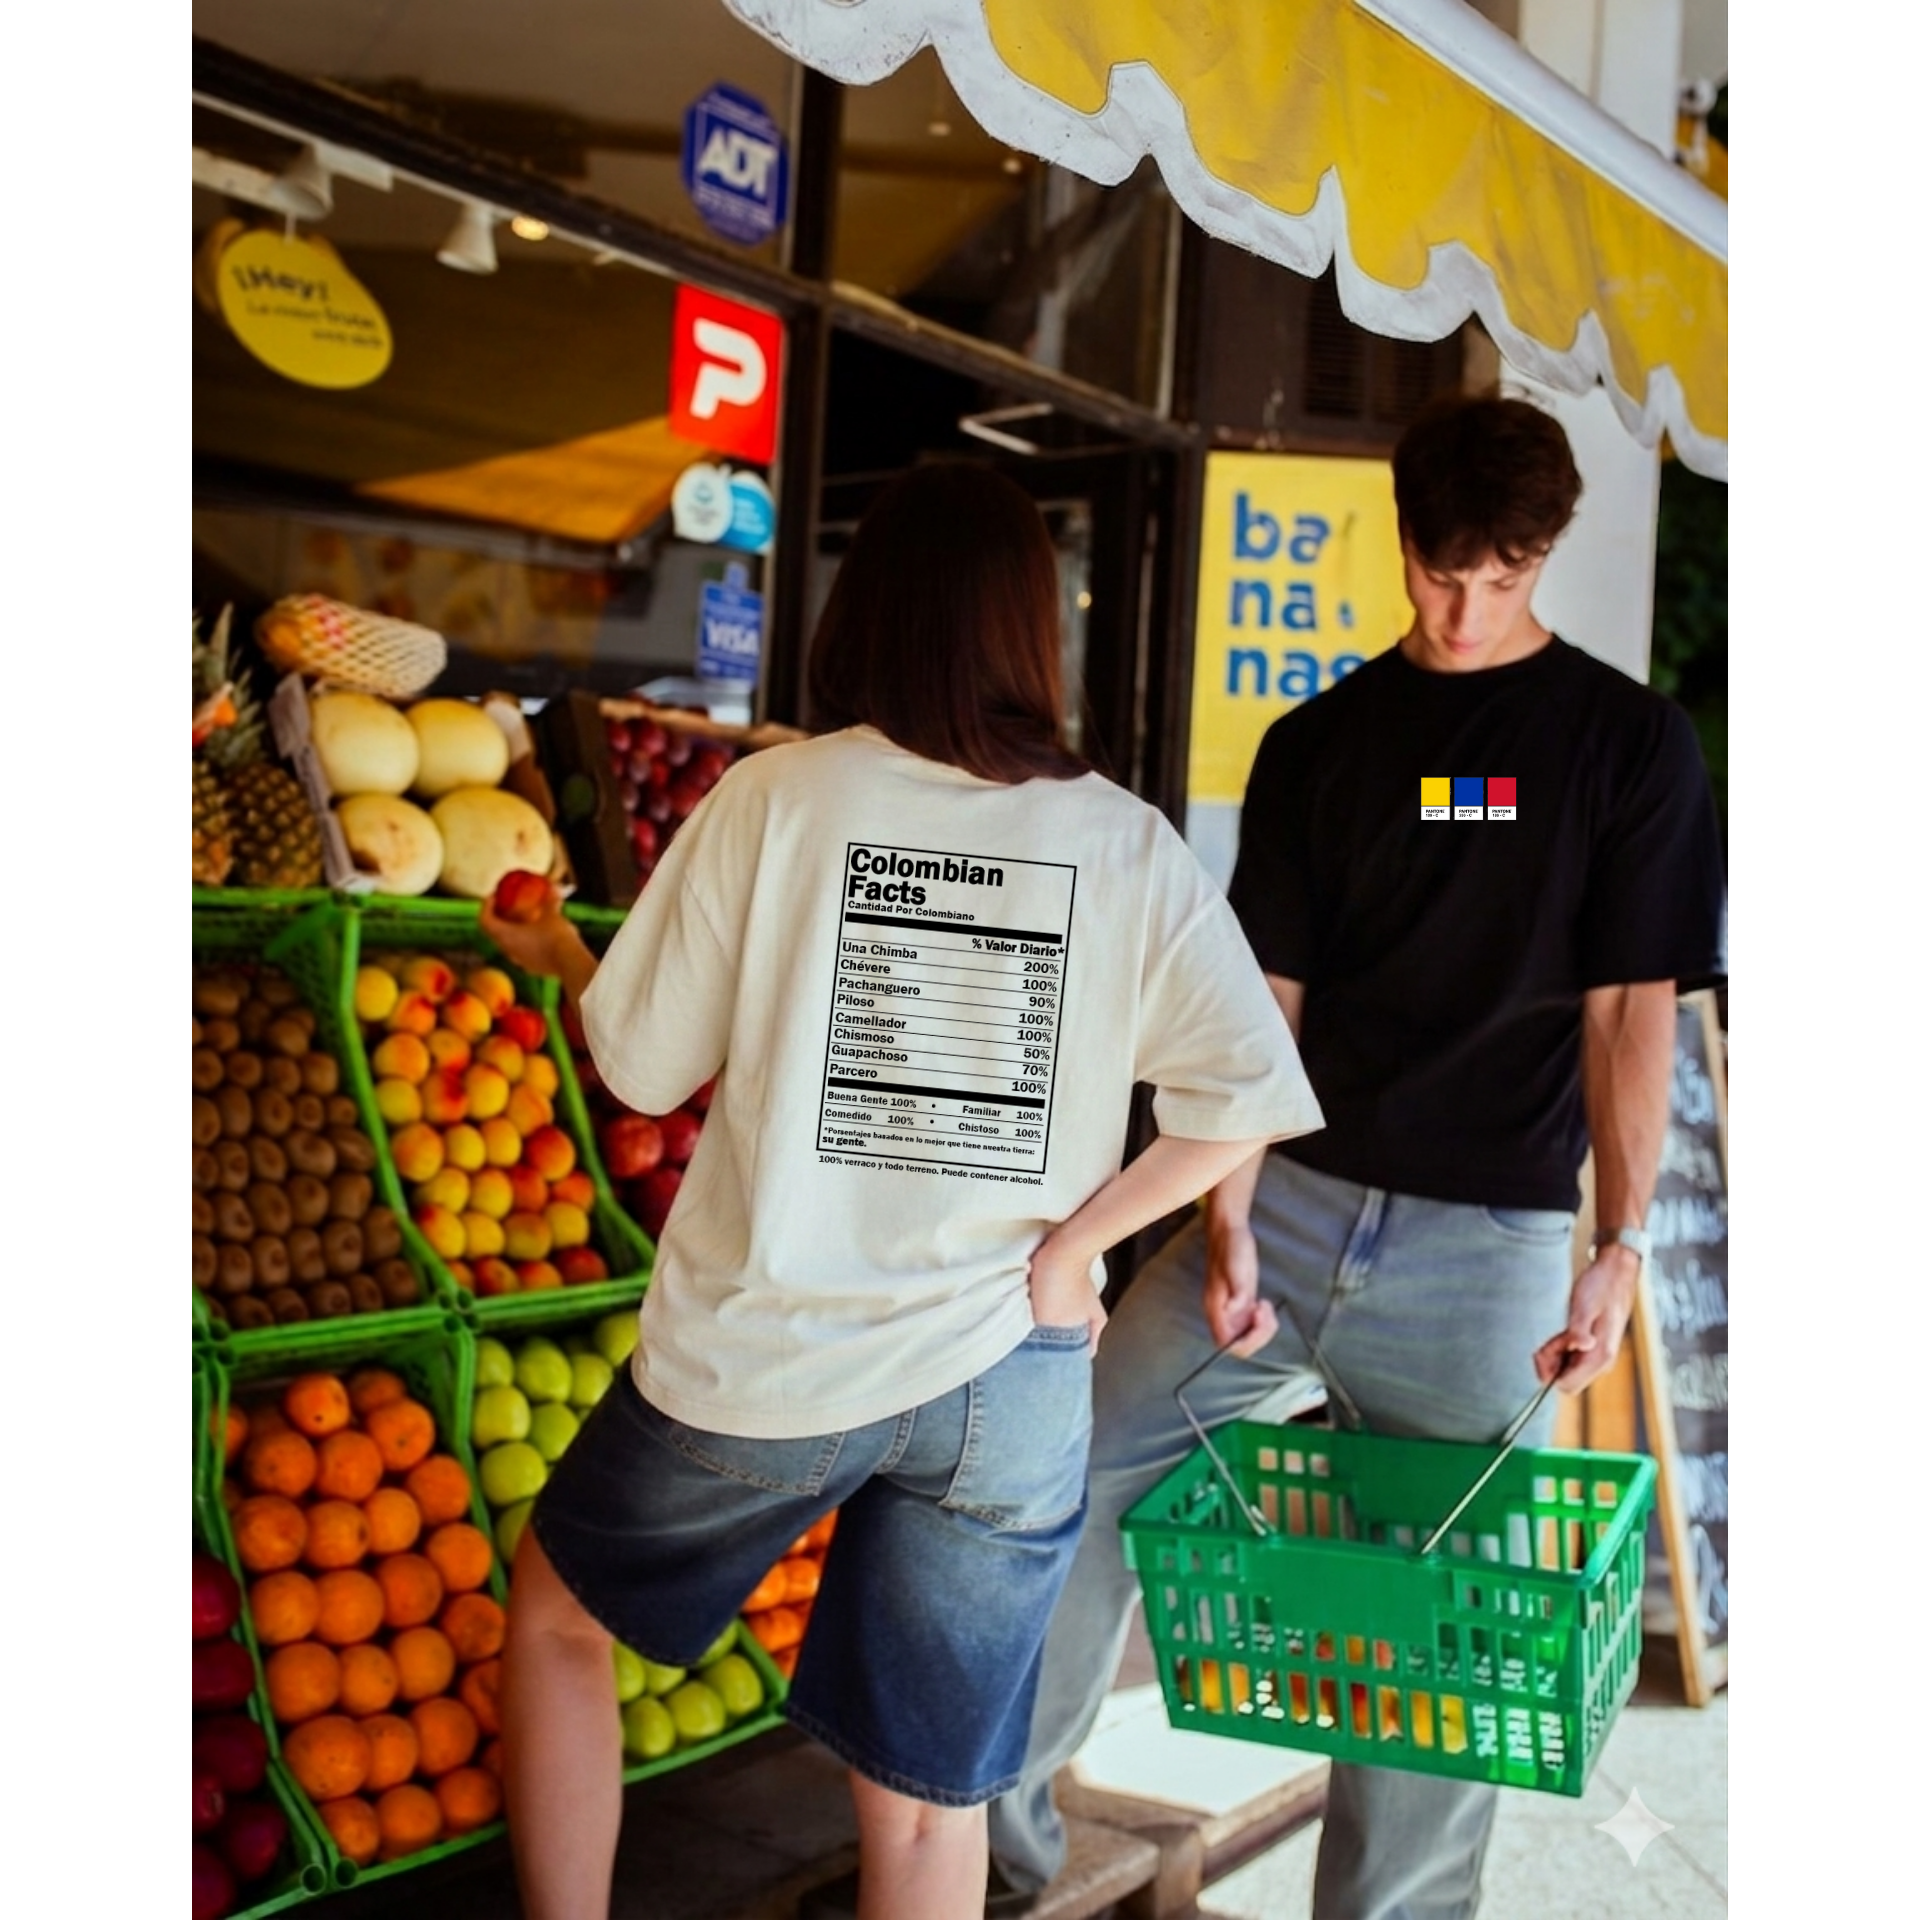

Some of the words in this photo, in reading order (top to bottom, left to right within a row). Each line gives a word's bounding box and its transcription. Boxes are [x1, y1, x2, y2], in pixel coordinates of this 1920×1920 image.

[699, 127, 775, 196] ADT
[689, 317, 767, 419] P
[1234, 492, 1330, 563] ba
[706, 619, 760, 655] VISA
[850, 848, 1004, 887] Colombian
[848, 874, 926, 905] Facts
[848, 900, 893, 913] Cantidad
[895, 905, 913, 915] Por
[915, 907, 975, 921] Colombiano
[842, 941, 867, 954] Una
[870, 944, 918, 959] Chimba
[1023, 961, 1059, 975] 200%
[972, 937, 982, 949] %
[985, 939, 1017, 952] Valor
[840, 959, 891, 974] Chévere
[1022, 979, 1057, 993] 100%
[838, 977, 921, 995] Pachanguero
[1029, 996, 1055, 1009] 90%
[837, 993, 875, 1008] Piloso
[1018, 1013, 1054, 1026] 100%
[835, 1012, 907, 1029] Camellador
[1016, 1029, 1052, 1043] 100%
[834, 1028, 895, 1044] Chismoso
[1023, 1047, 1050, 1060] 50%
[831, 1044, 908, 1062] Guapachoso
[1022, 1064, 1048, 1077] 70%
[829, 1063, 878, 1078] Parcero
[1011, 1081, 1046, 1095] 100%
[827, 1091, 858, 1102] Buena
[860, 1094, 888, 1105] Gente
[890, 1097, 917, 1108] 100%
[962, 1105, 1001, 1117] Familiar
[1016, 1111, 1043, 1121] 100%
[824, 1108, 872, 1121] Comedido
[887, 1115, 914, 1126] 100%
[958, 1122, 1000, 1135] Chistoso
[1014, 1128, 1041, 1139] 100%
[835, 1137, 867, 1147] gente.
[873, 1131, 903, 1142] basados
[924, 1138, 946, 1147] mejor
[947, 1141, 961, 1149] que
[962, 1141, 981, 1150] tiene
[982, 1145, 1011, 1153] nuestra
[818, 1155, 843, 1165] 100%
[844, 1158, 876, 1168] verraco
[878, 1162, 884, 1171] y
[885, 1161, 904, 1171] todo
[905, 1164, 939, 1175] terreno.
[941, 1168, 968, 1178] Puede
[969, 1172, 1009, 1182] contener
[1009, 1175, 1044, 1186] alcohol.
